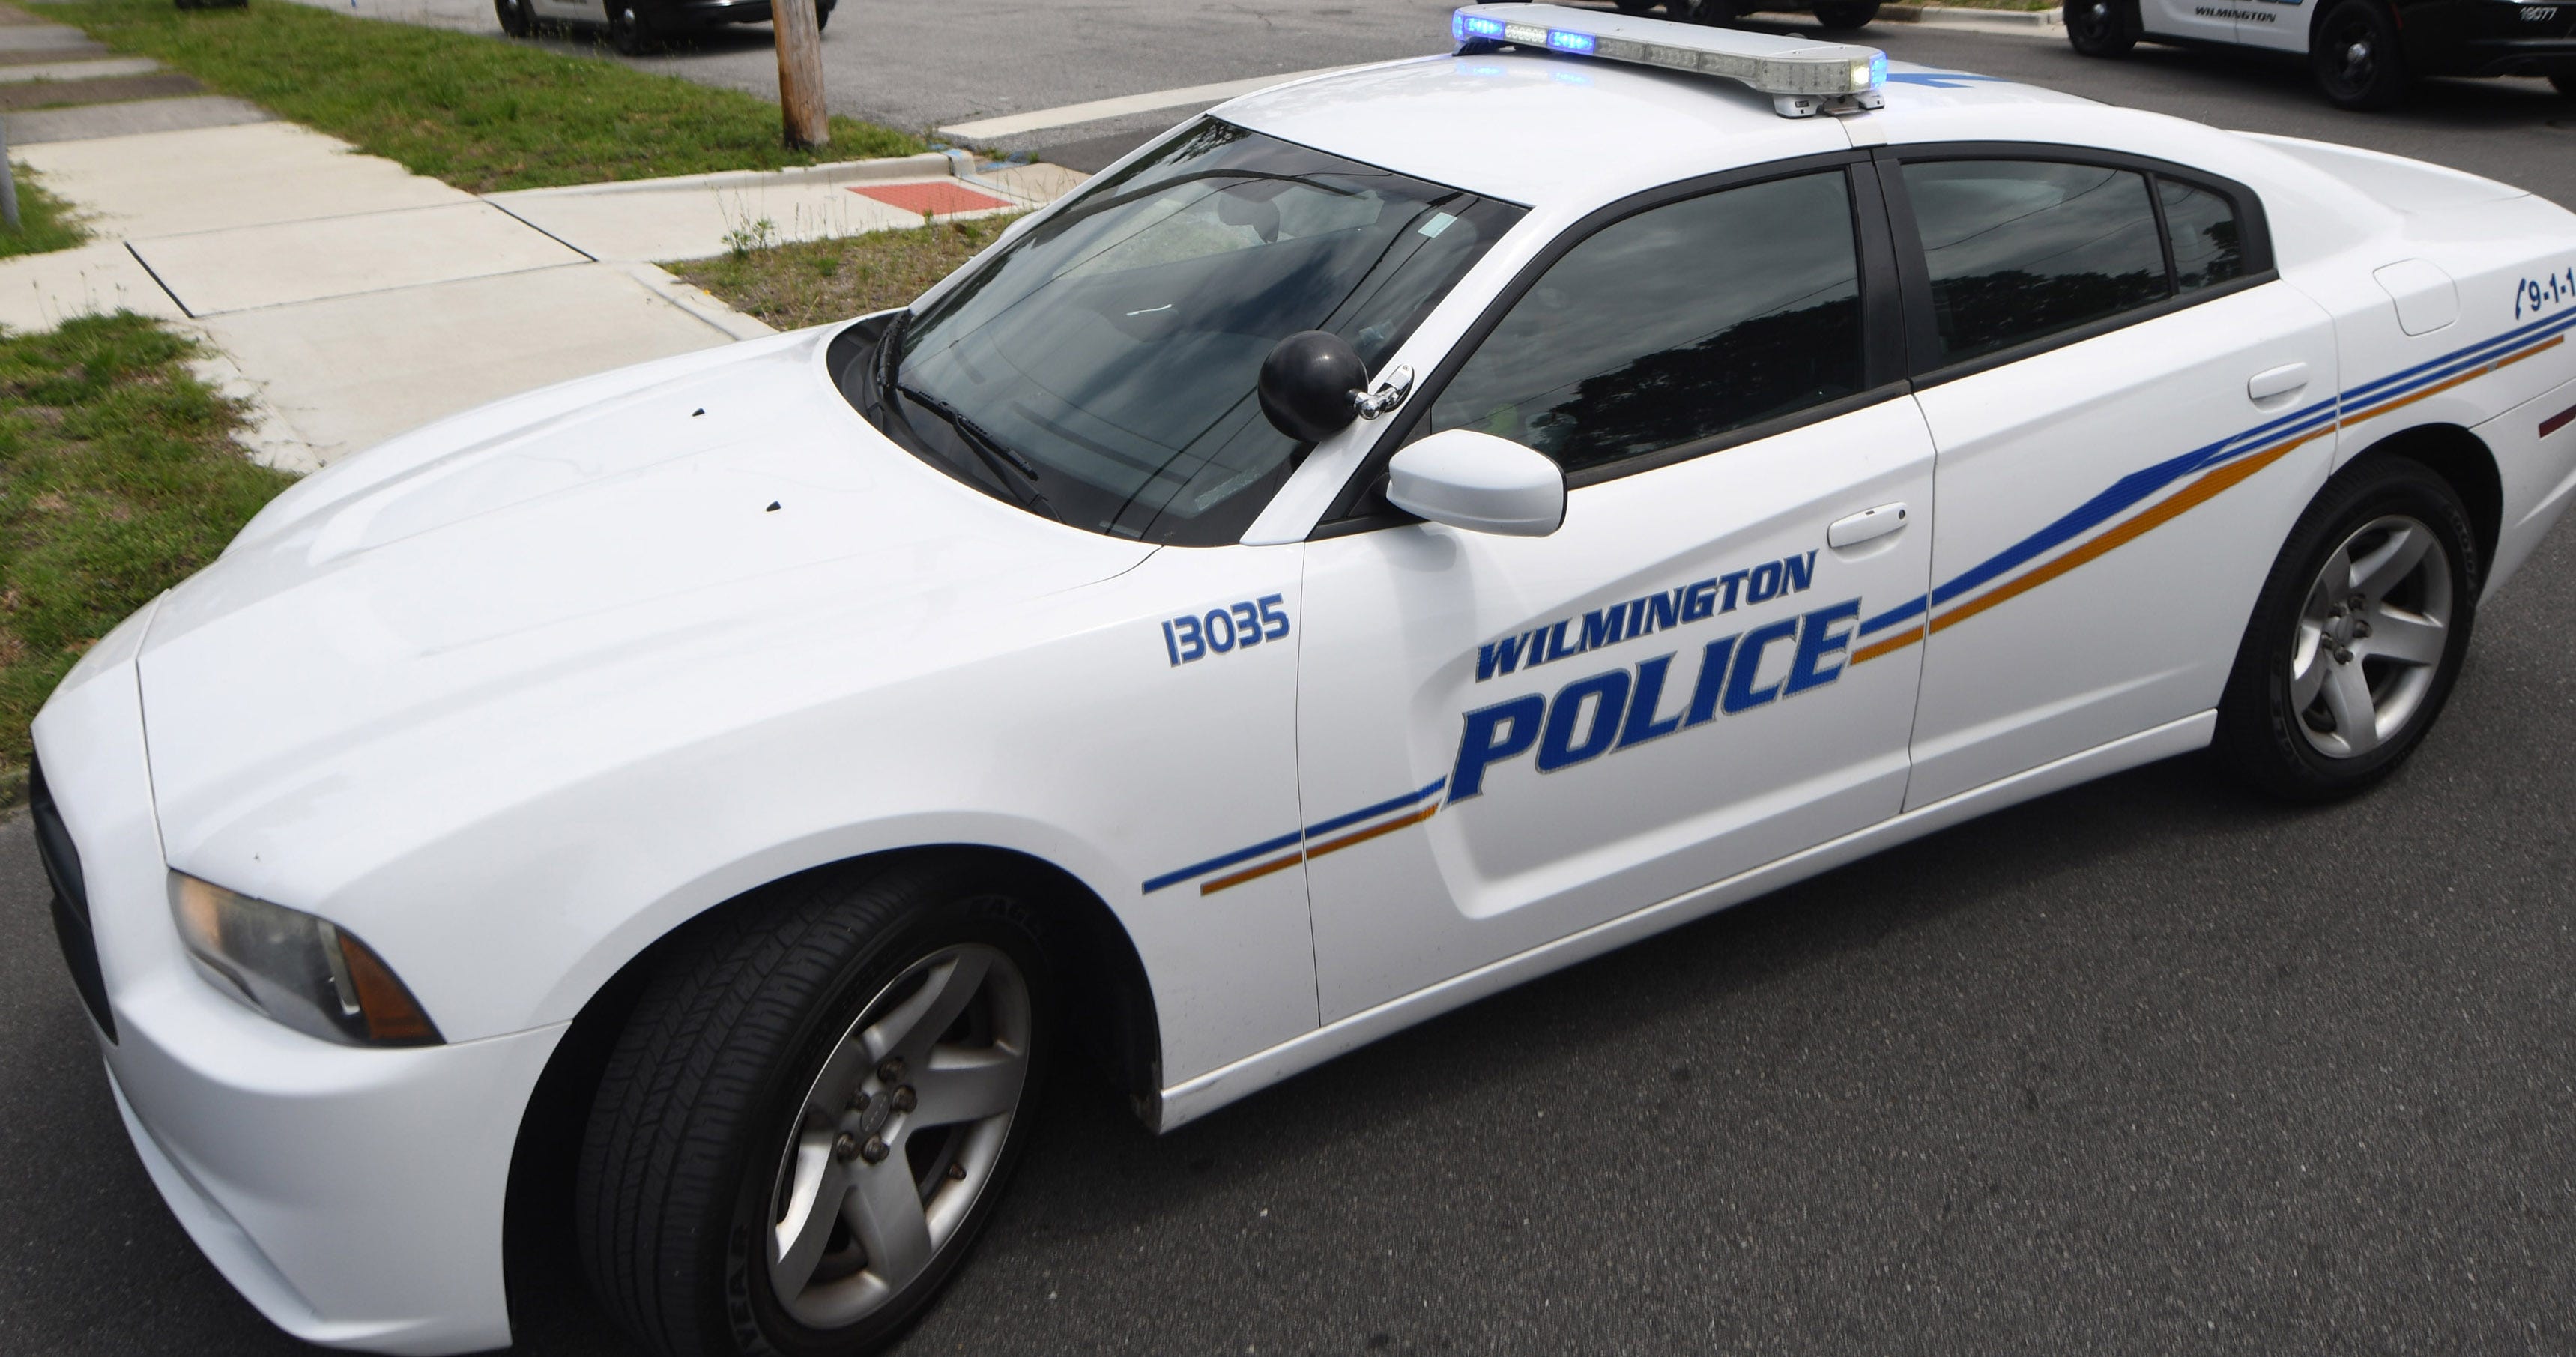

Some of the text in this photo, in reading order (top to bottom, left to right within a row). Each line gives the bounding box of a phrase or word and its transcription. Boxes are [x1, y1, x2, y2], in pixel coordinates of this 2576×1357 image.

[2195, 6, 2276, 22] WILMINGTON
[1161, 592, 1291, 668] 13035
[1475, 548, 1818, 681] WILMINGTON
[1442, 597, 1862, 809] POLICE
